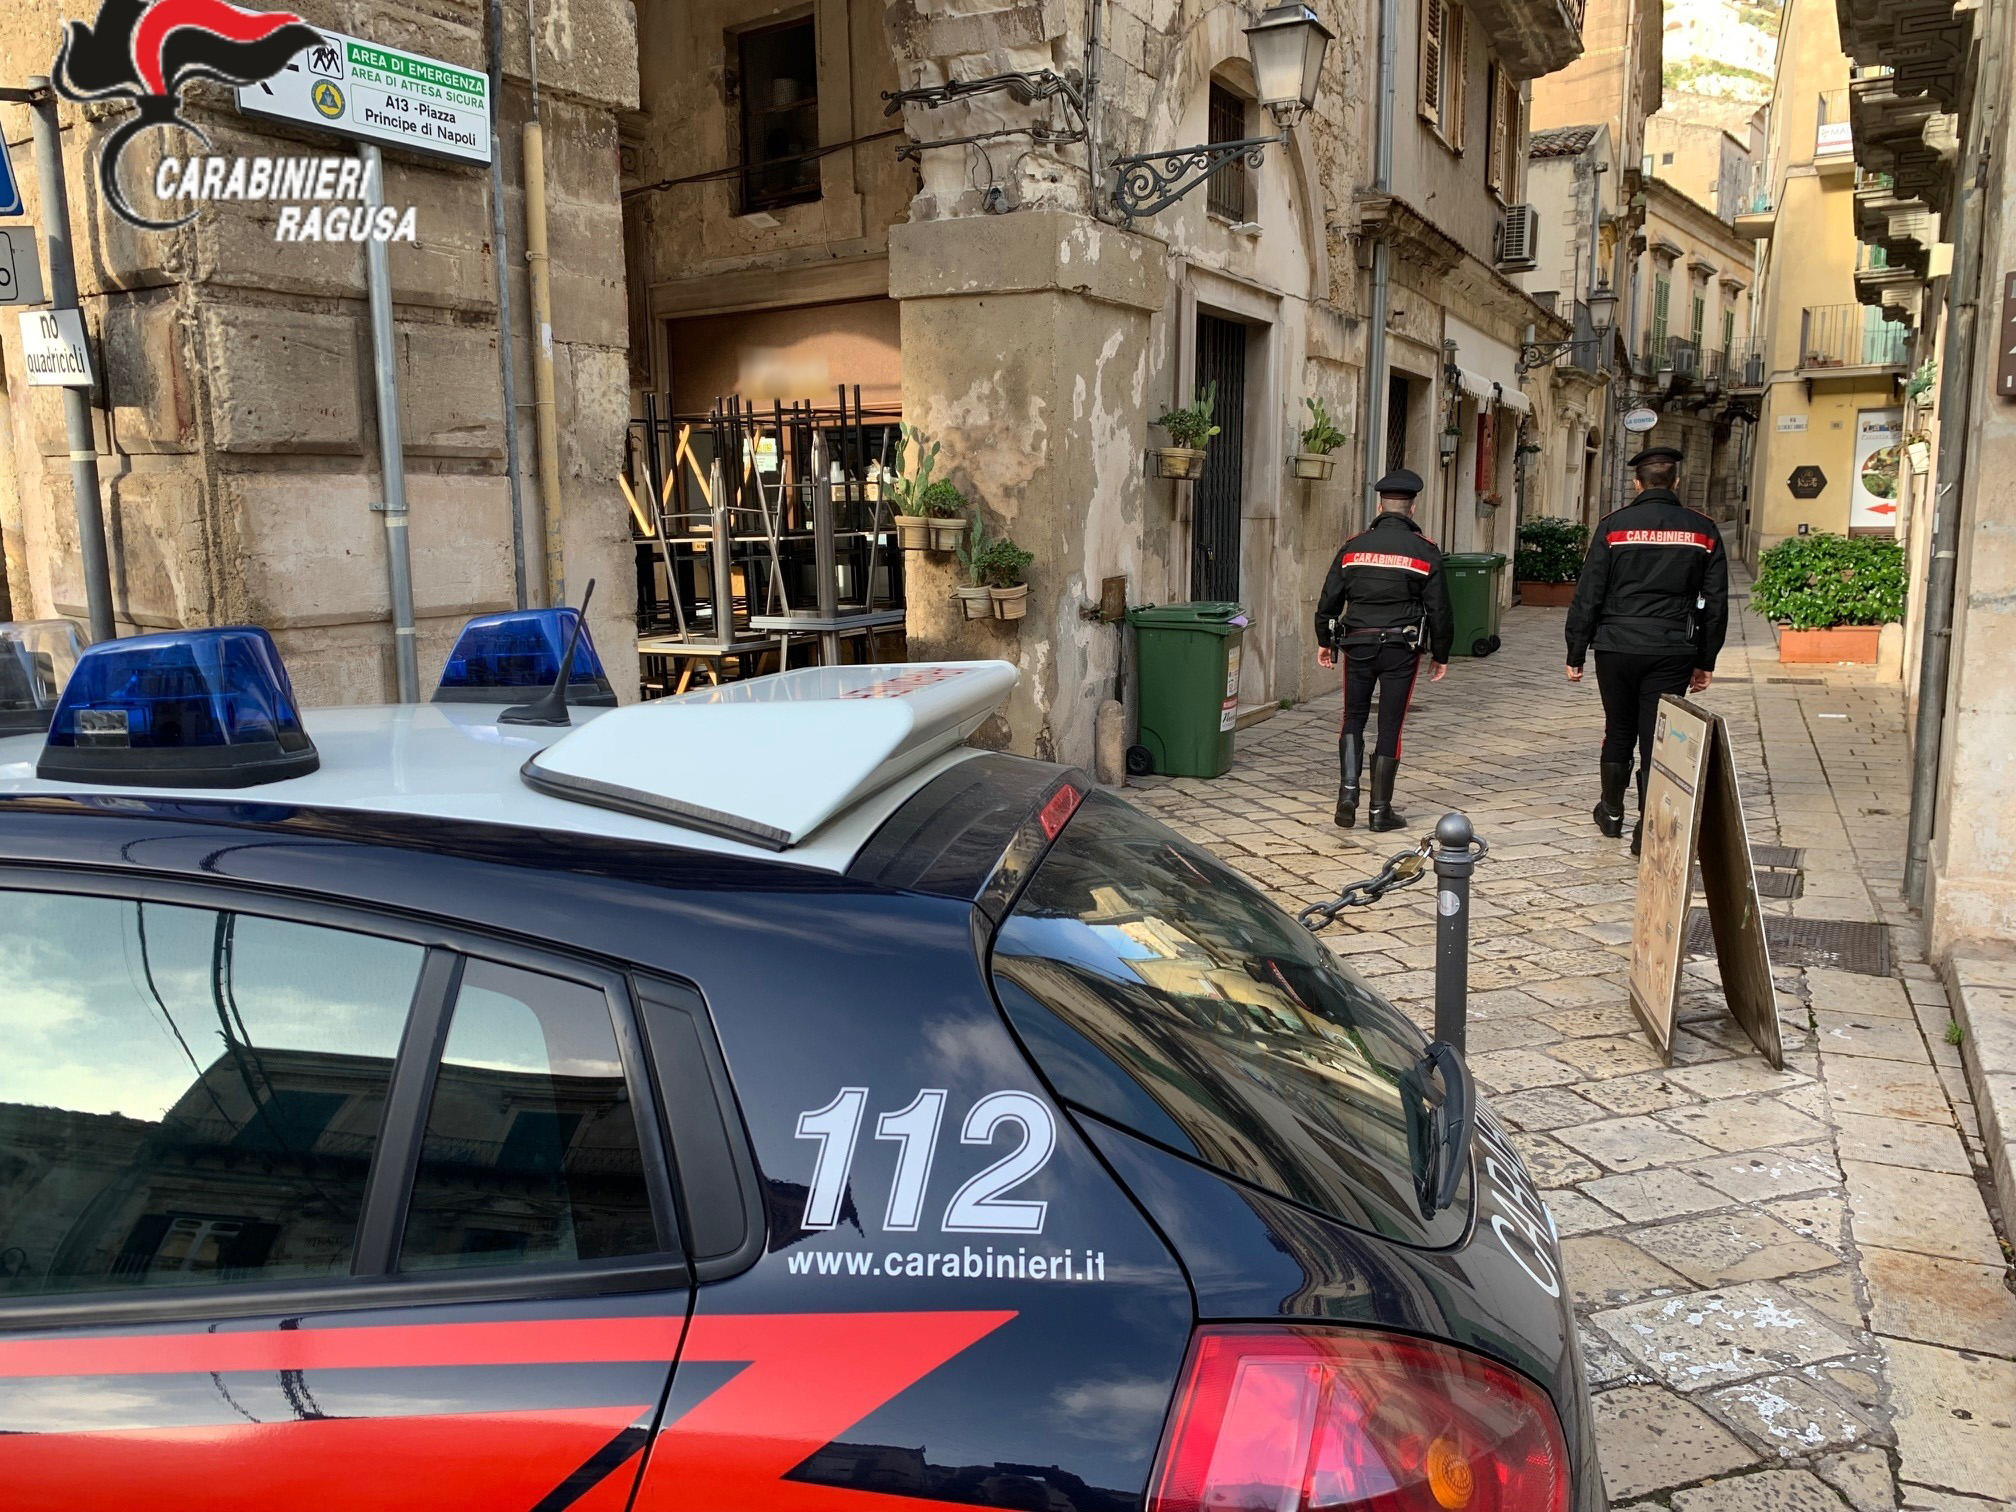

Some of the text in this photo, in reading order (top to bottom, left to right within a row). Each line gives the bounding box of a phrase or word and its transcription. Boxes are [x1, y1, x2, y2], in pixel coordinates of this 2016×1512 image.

[352, 48, 484, 94] AREA DI EMERGENZA
[351, 66, 485, 110] AREA DI ATTESA SICURA
[386, 95, 409, 112] A13
[365, 108, 476, 146] Principe di Napoli
[39, 314, 59, 339] no
[27, 344, 86, 374] quadricicli
[1626, 530, 1695, 543] CARABINIERI
[1353, 552, 1413, 567] CARABINIERI
[794, 1086, 1058, 1235] 112
[787, 1245, 1105, 1282] www.carabinieri.it
